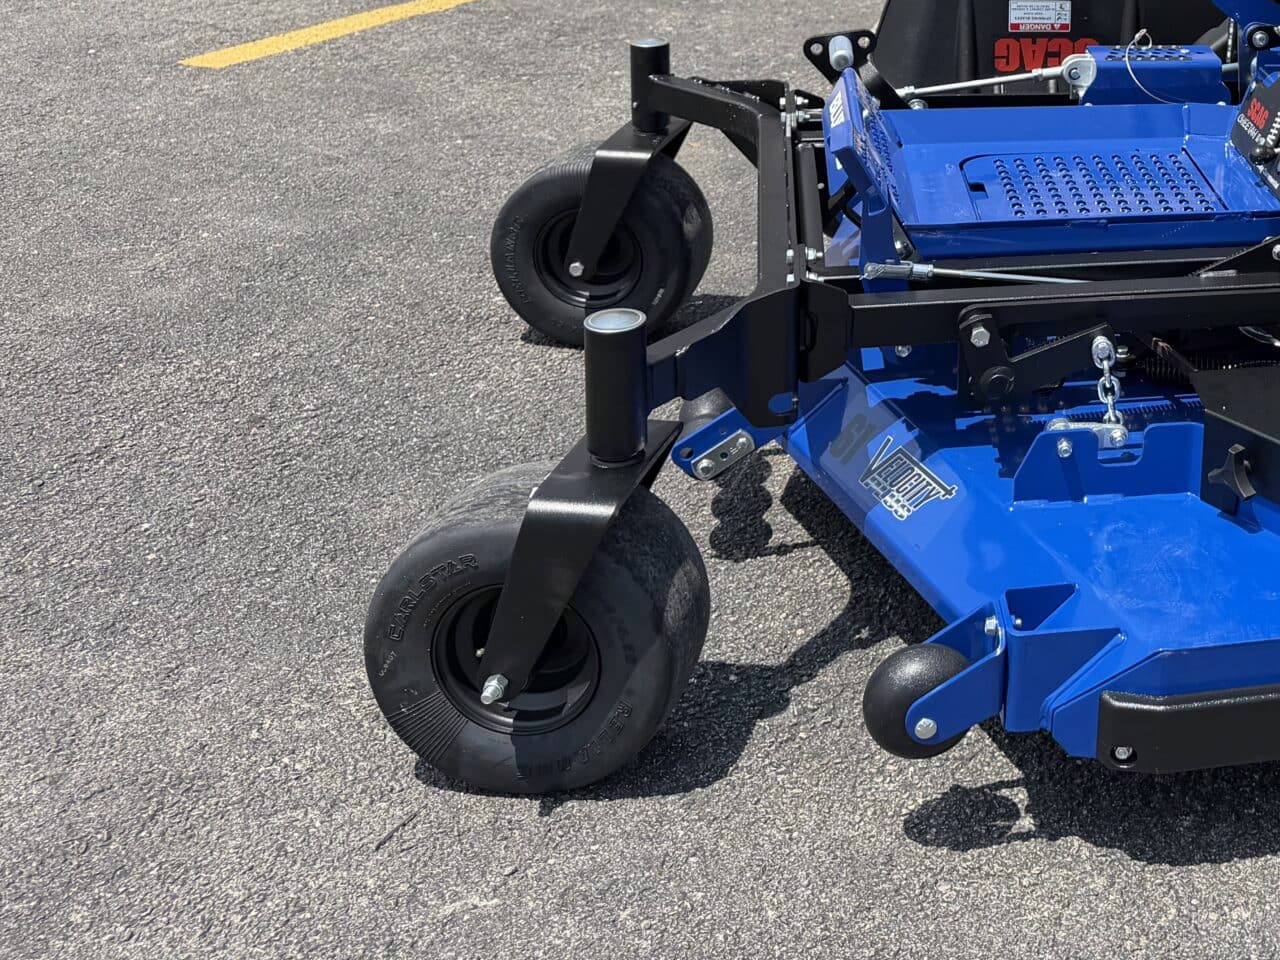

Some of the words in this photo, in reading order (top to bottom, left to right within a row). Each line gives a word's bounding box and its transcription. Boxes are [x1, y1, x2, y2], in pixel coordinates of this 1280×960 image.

[859, 436, 957, 512] VELOCITY
[865, 474, 913, 521] PLUS
[388, 553, 479, 641] CARLSTAR
